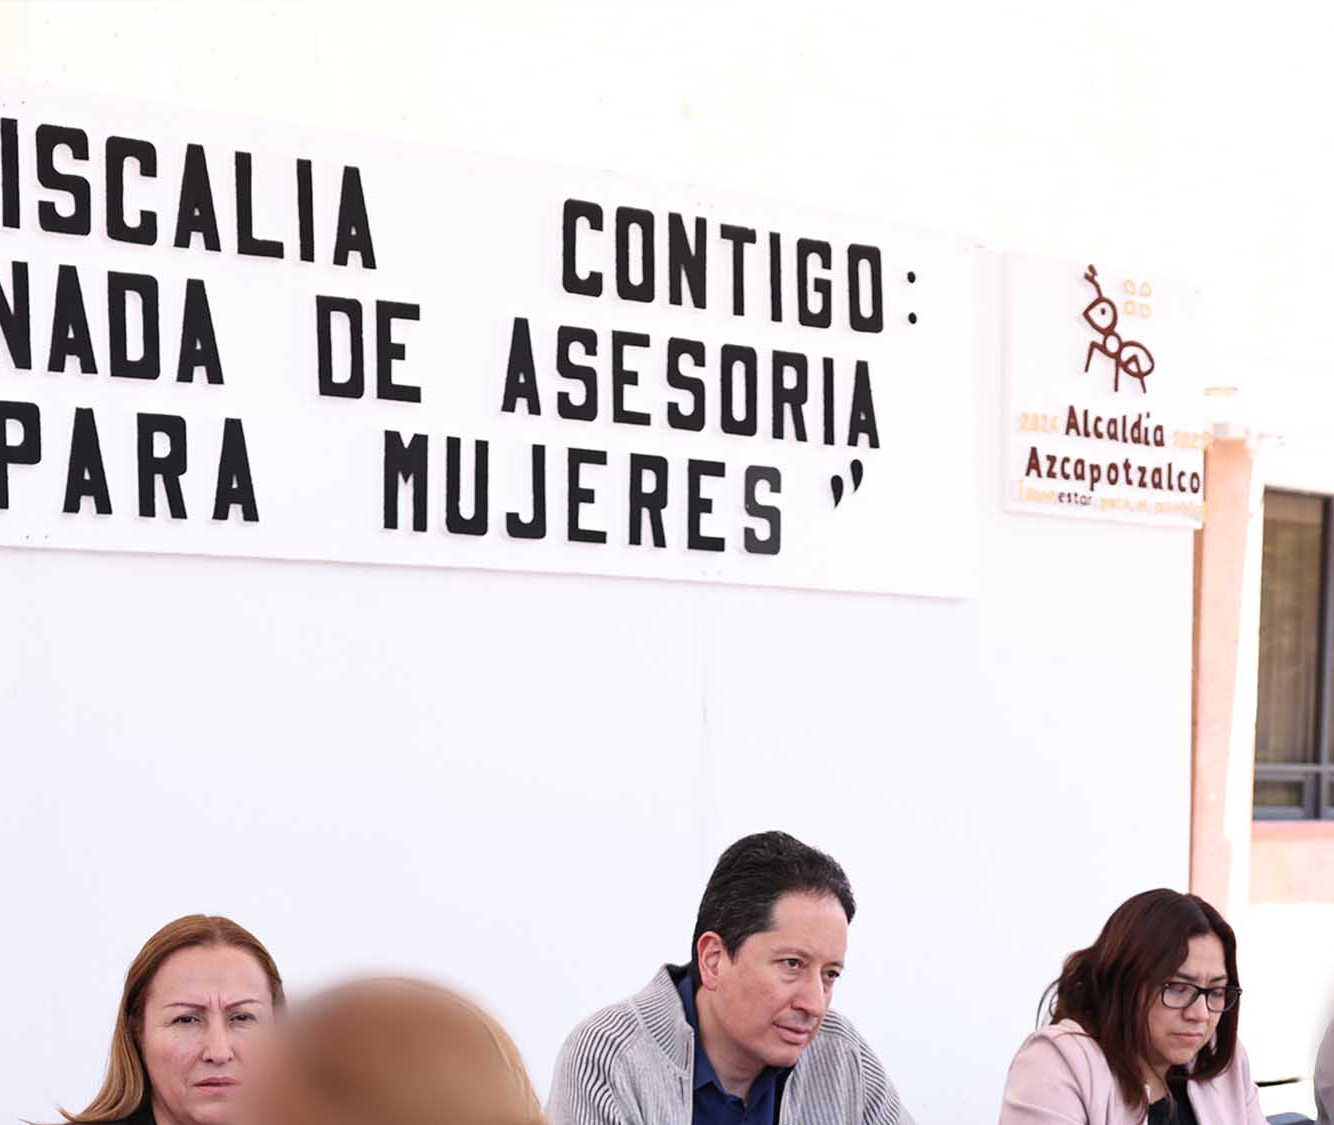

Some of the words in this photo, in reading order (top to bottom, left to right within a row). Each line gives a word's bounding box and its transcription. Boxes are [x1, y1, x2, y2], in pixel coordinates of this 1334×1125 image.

[561, 198, 918, 335] CONTIGO:
[315, 294, 422, 404] DE
[500, 316, 880, 450] ASESORIA
[383, 429, 782, 556] MUJERES
[1024, 445, 1201, 495] Azcapotzalco
